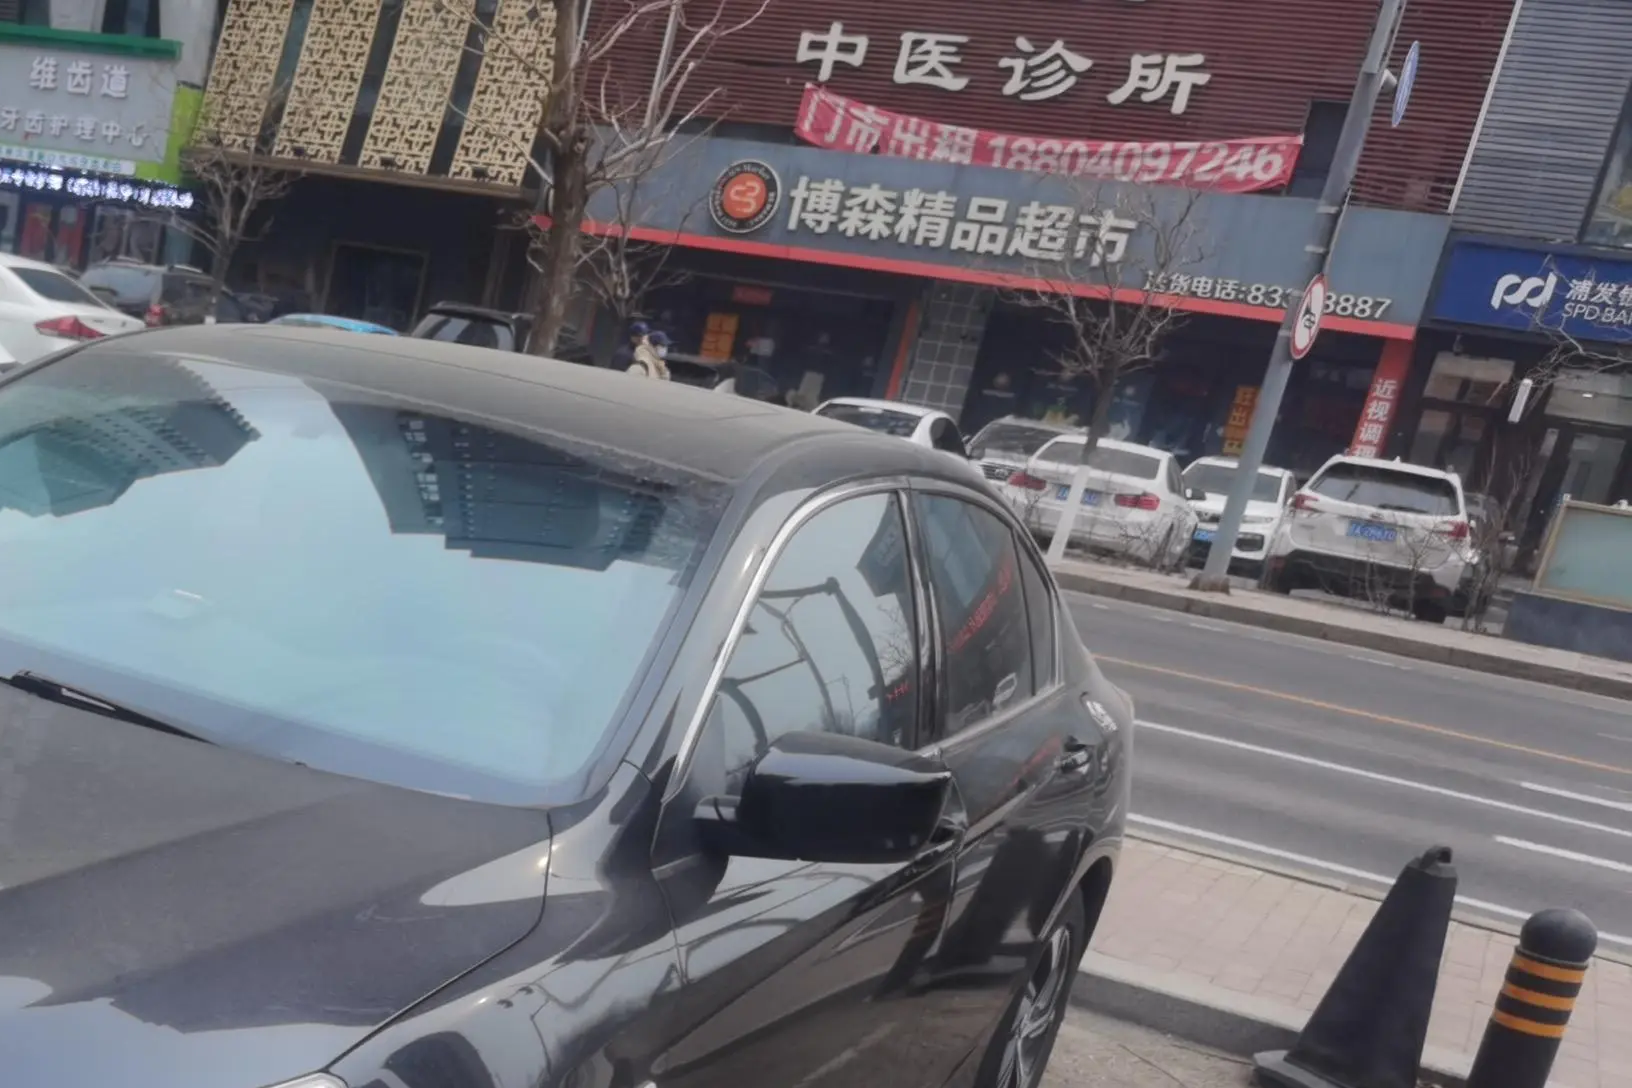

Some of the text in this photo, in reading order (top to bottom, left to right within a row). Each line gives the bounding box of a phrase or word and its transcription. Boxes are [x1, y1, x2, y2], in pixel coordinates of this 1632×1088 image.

[29, 56, 130, 98] 维齿道
[796, 21, 1211, 115] 中医诊所
[0, 107, 151, 147] 牙齿护理中心
[803, 91, 978, 165] 门市出租
[786, 176, 1138, 267] 博森精品超市
[1563, 302, 1601, 321] SPD
